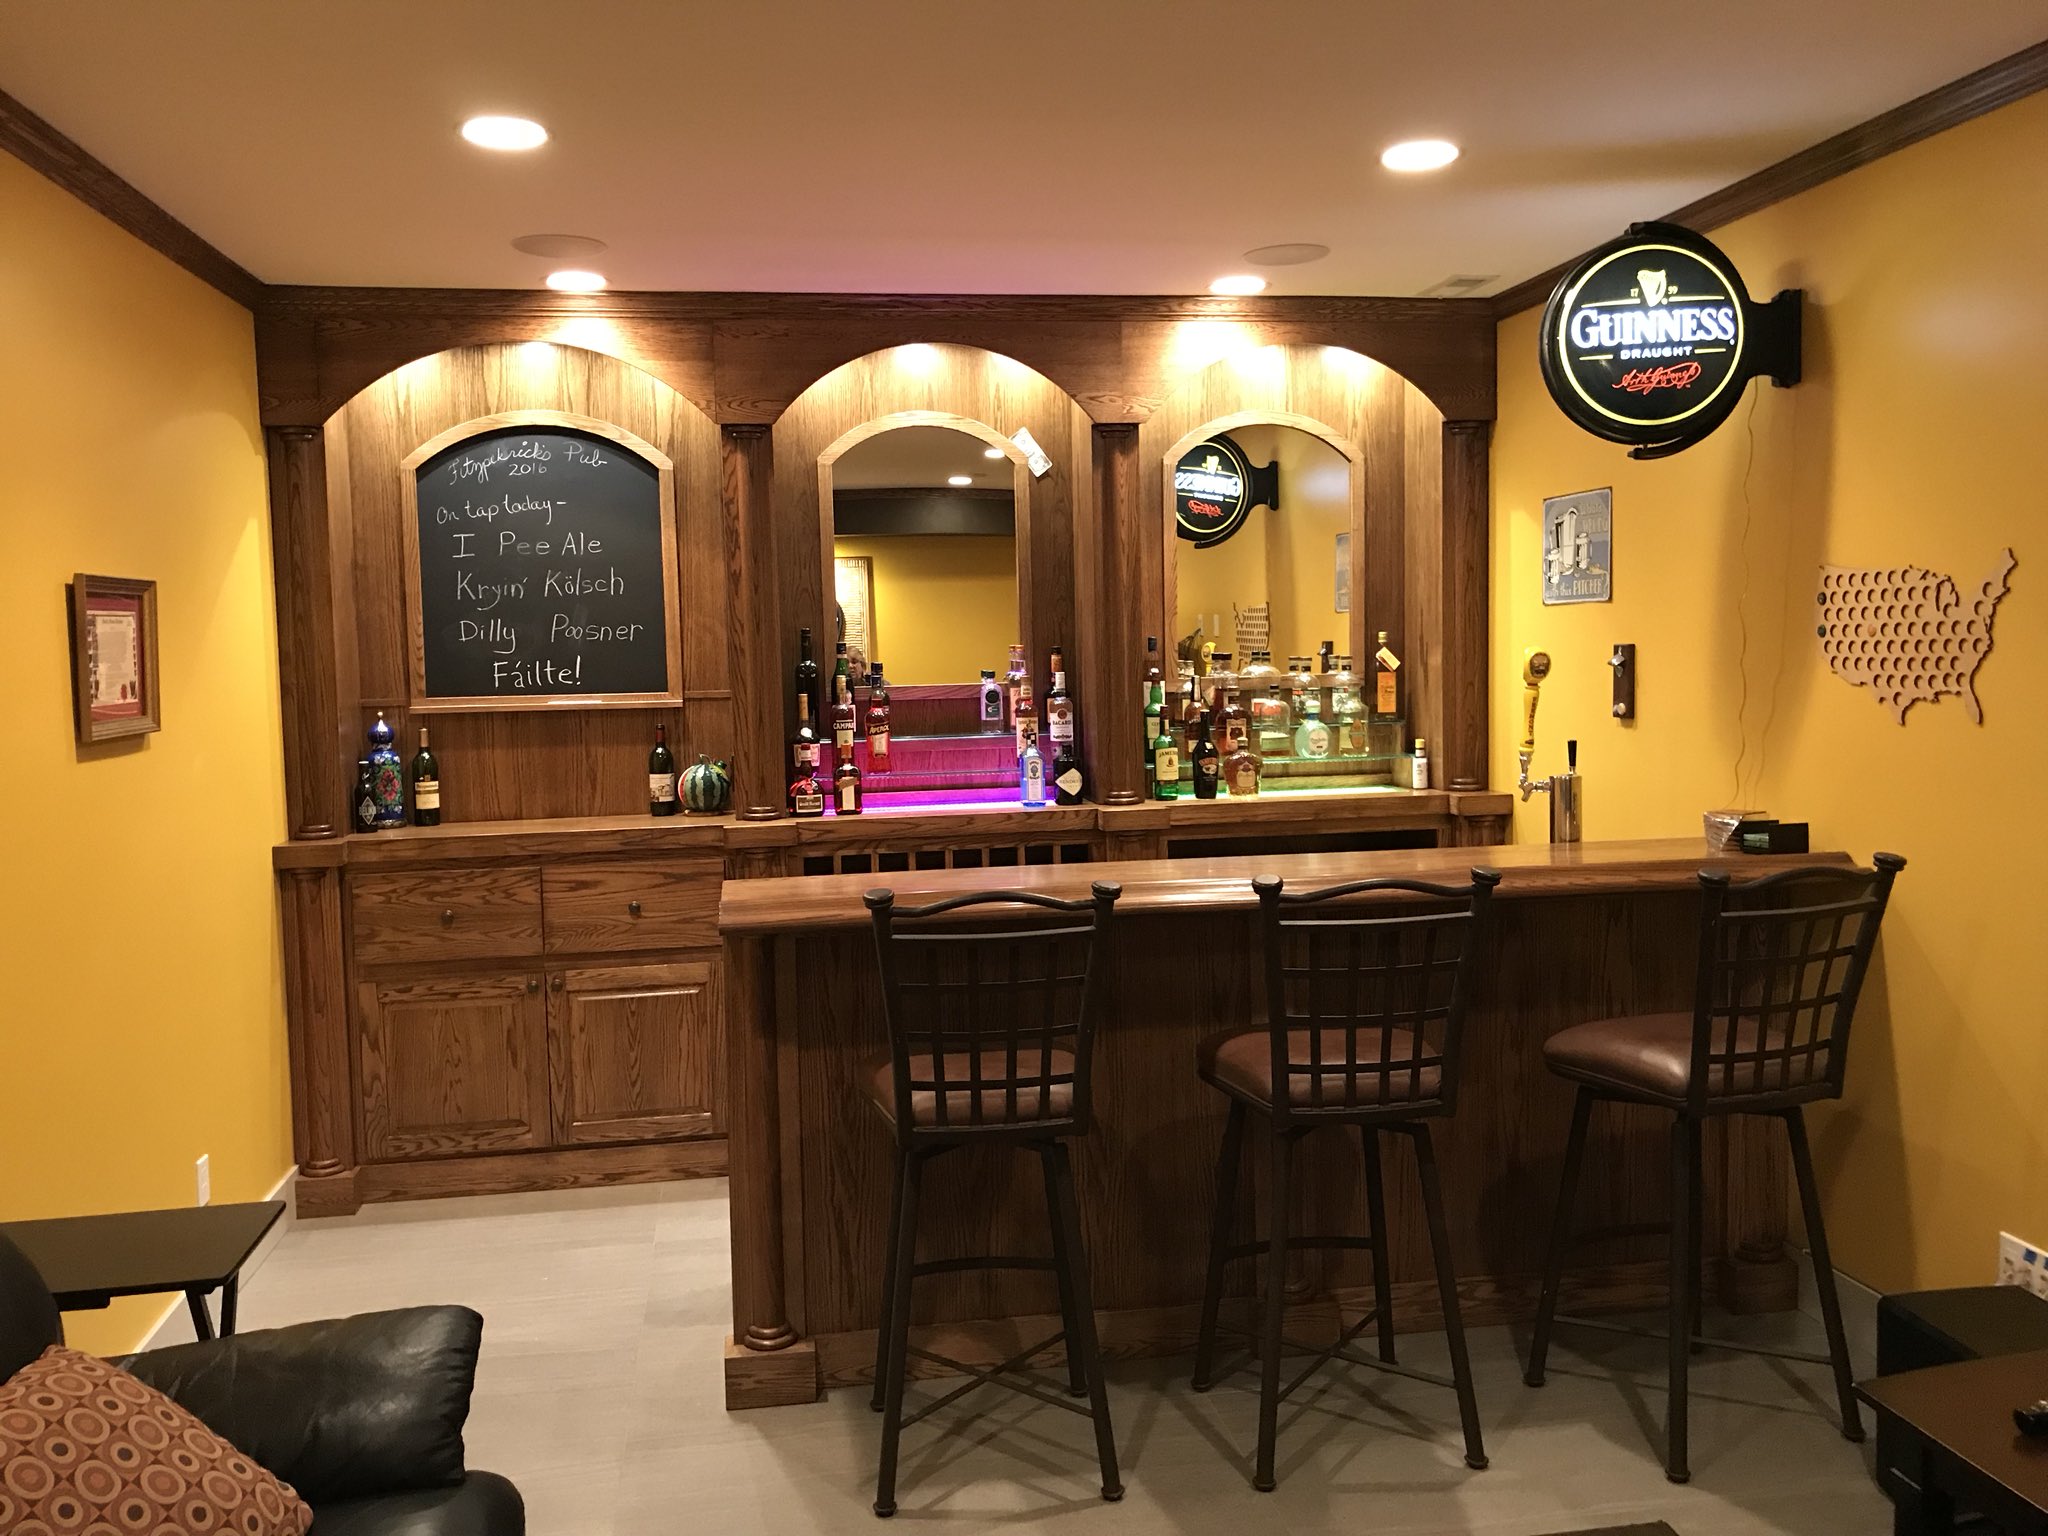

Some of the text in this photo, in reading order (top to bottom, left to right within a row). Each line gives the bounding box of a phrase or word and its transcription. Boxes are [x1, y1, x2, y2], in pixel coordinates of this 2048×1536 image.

[1571, 308, 1735, 348] GUINNESS
[1620, 346, 1692, 359] DRAUGHT
[562, 441, 608, 467] Pub
[508, 463, 547, 476] 2016
[436, 507, 459, 524] On
[464, 500, 499, 523] tap
[452, 531, 602, 558] I Pee Ale
[544, 567, 624, 598] Kölsch
[459, 613, 644, 654] Dilly Poosner
[493, 655, 581, 688] Fáilte!
